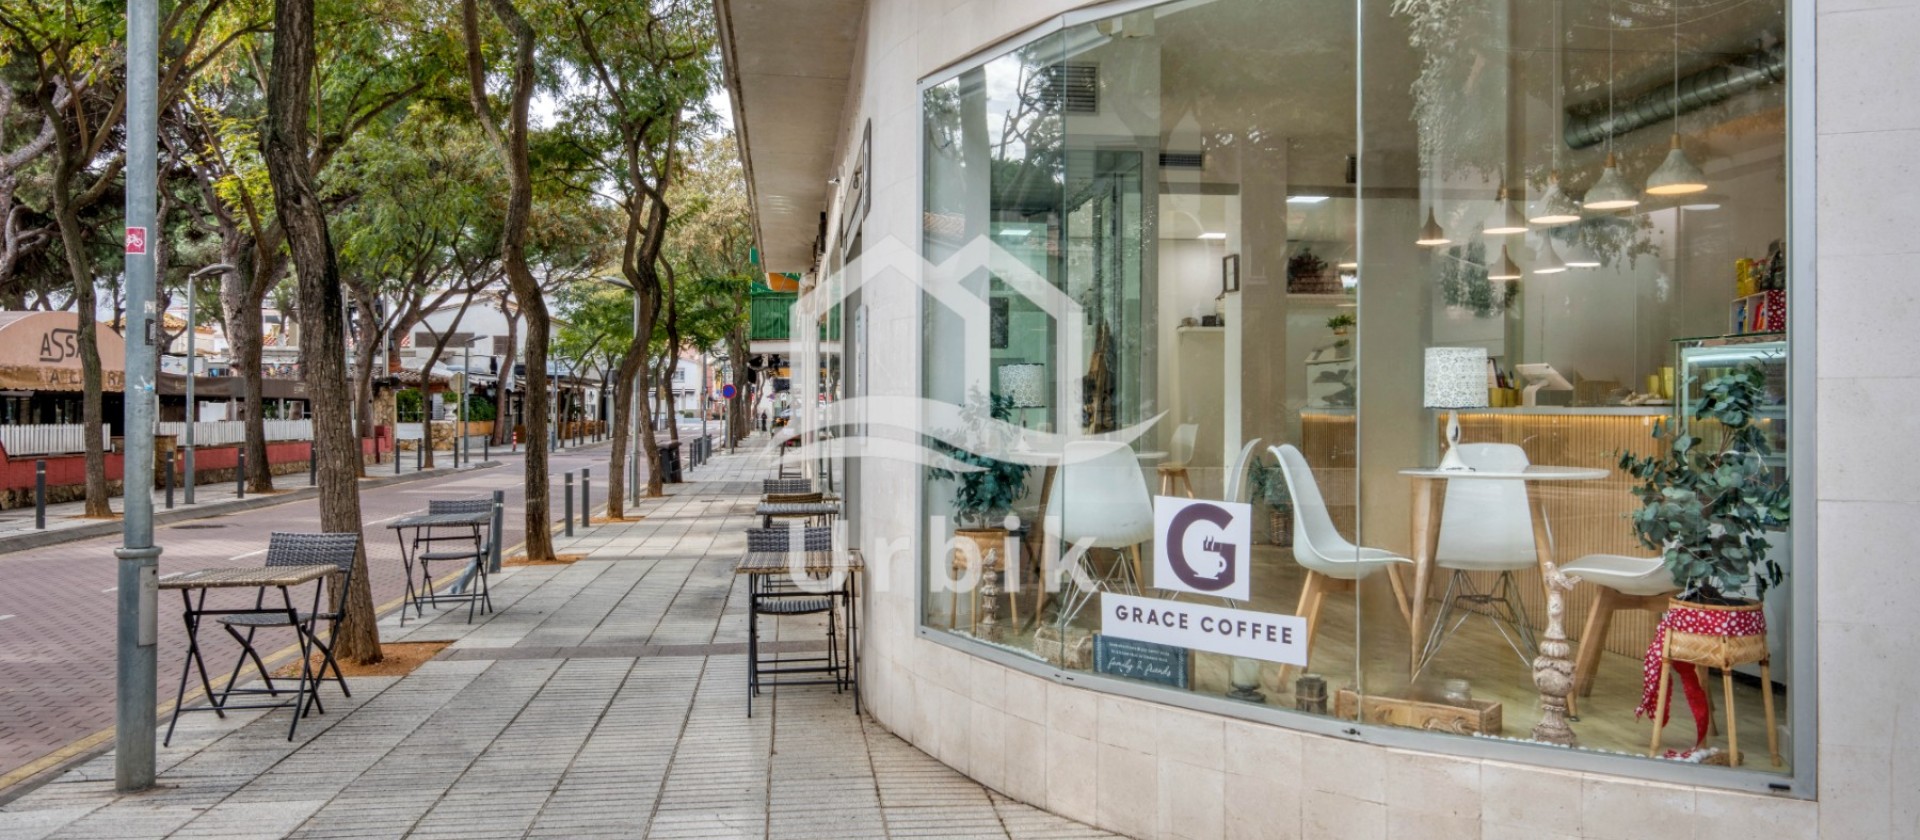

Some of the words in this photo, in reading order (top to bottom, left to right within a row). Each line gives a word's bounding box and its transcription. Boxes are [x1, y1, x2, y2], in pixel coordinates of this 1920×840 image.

[1166, 503, 1236, 591] G
[1115, 604, 1189, 630] GRACE
[1200, 616, 1293, 645] COFFEE
